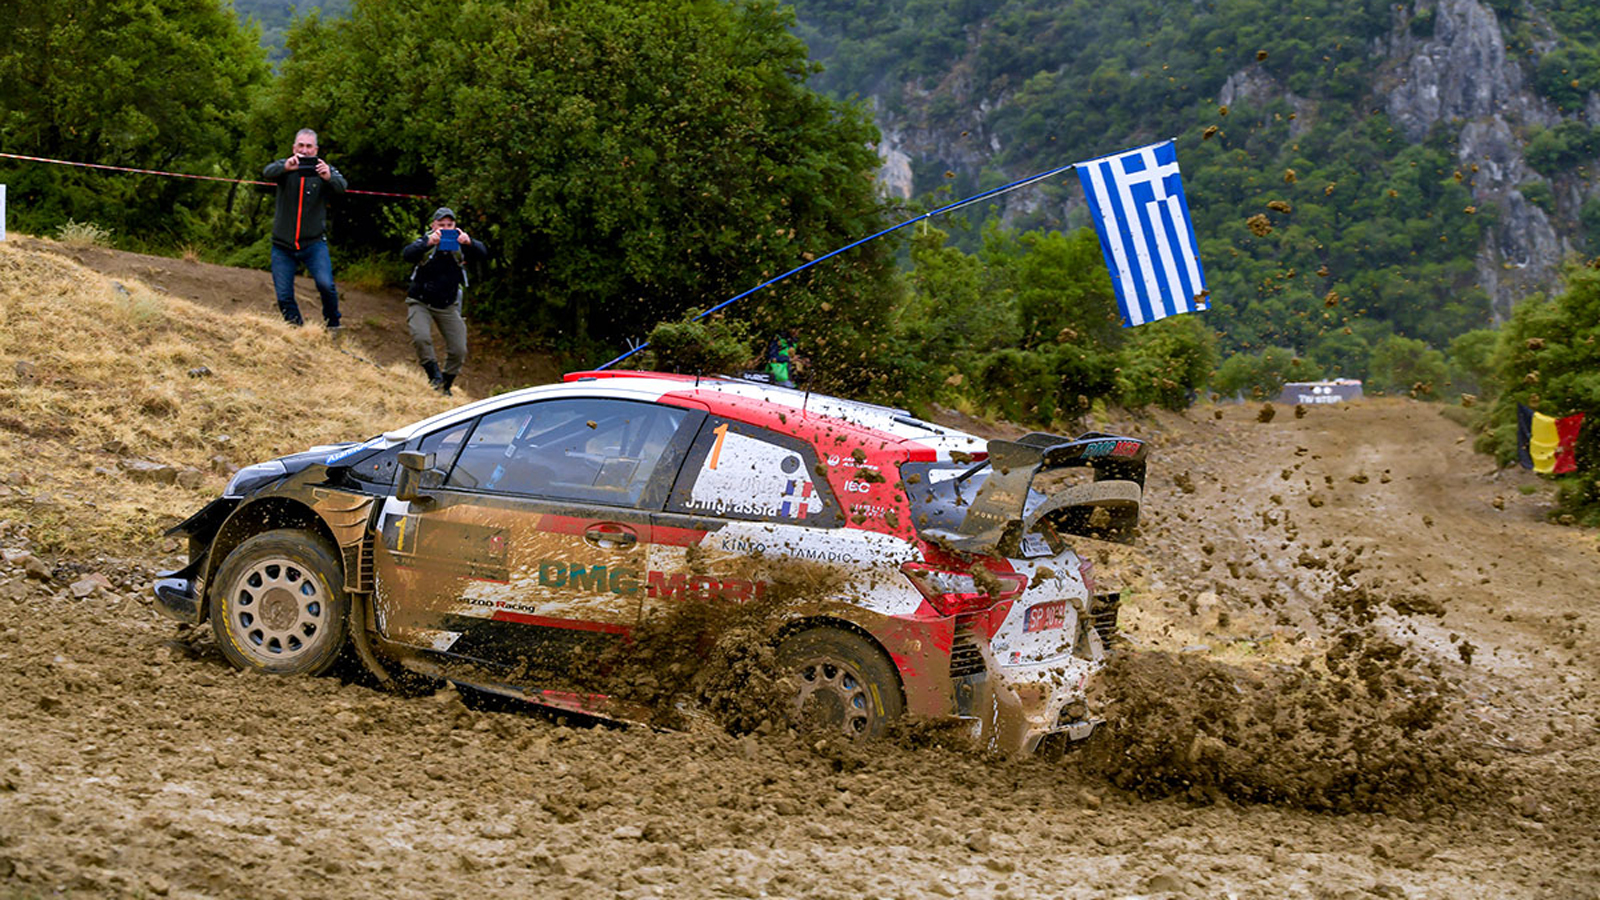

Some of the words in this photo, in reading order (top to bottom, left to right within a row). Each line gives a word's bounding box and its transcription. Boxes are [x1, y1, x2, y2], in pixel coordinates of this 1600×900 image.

[709, 423, 729, 470] 1
[395, 516, 407, 551] 1
[722, 539, 766, 553] KINTO
[539, 558, 640, 596] DMG
[496, 601, 535, 613] Racing
